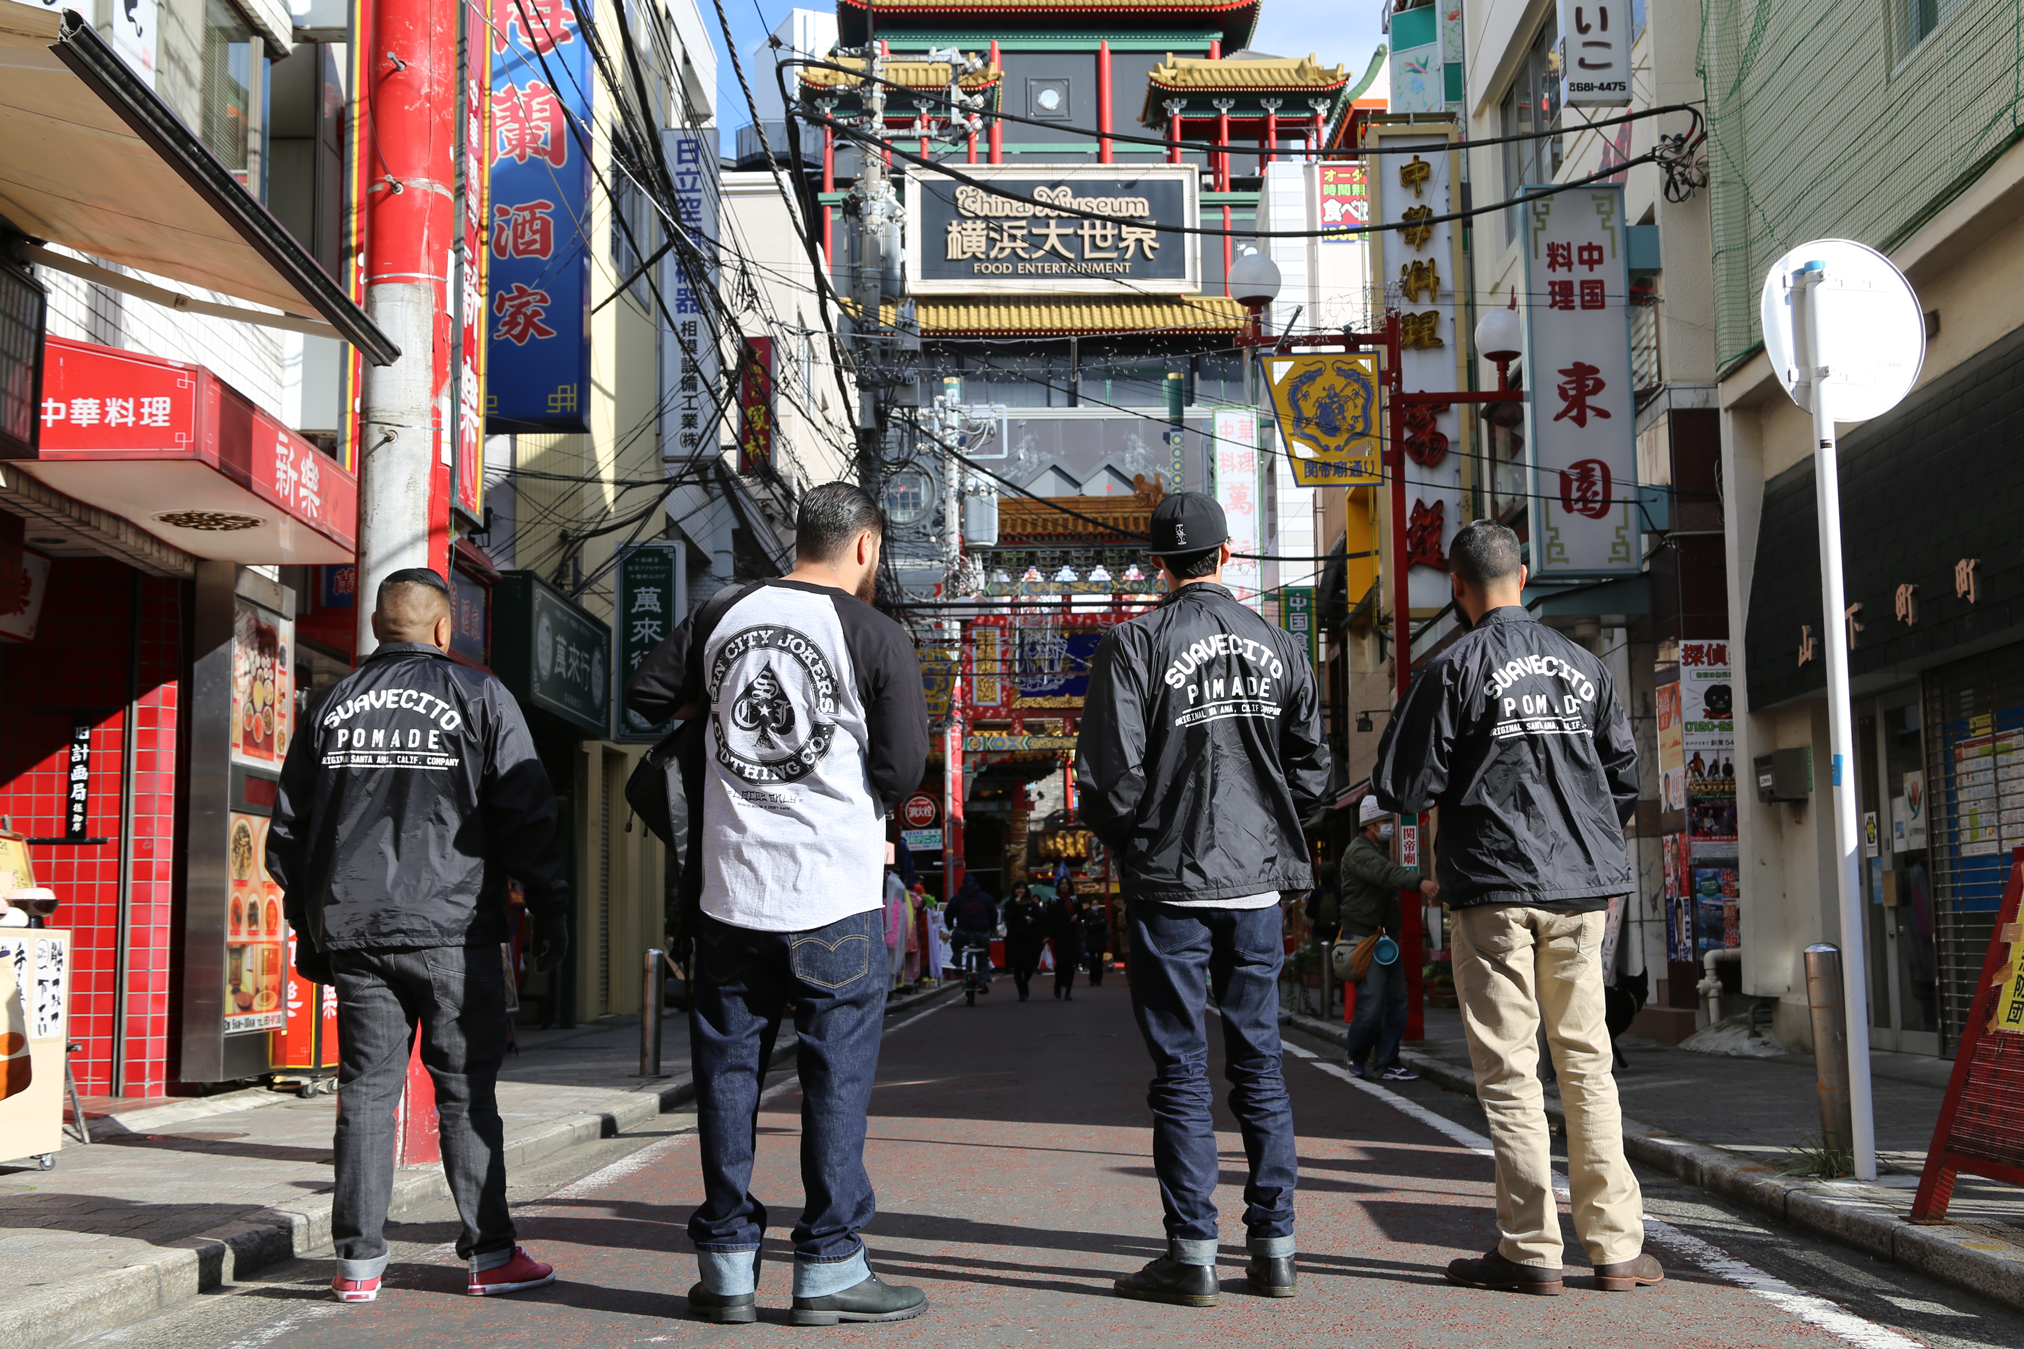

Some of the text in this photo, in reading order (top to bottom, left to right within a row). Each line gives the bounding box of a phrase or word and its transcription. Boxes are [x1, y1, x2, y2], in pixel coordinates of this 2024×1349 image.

[955, 185, 1034, 218] China
[946, 219, 1160, 260] 横浜大世界
[973, 262, 1013, 275] FOOD
[40, 396, 171, 428] 中華料理
[710, 629, 835, 714] SIN CITY JOKERS
[1164, 633, 1283, 690] SUAVECITO
[1483, 654, 1595, 702] SUAVECITO
[323, 688, 462, 731] SUAVECITO
[1174, 711, 1207, 727] ORIGINAL
[337, 728, 440, 749] POMADE
[351, 755, 373, 764] SANTA
[397, 756, 422, 765] CALIF.
[426, 757, 460, 767] COMPANY
[1721, 869, 1740, 950] 地球一周の船
